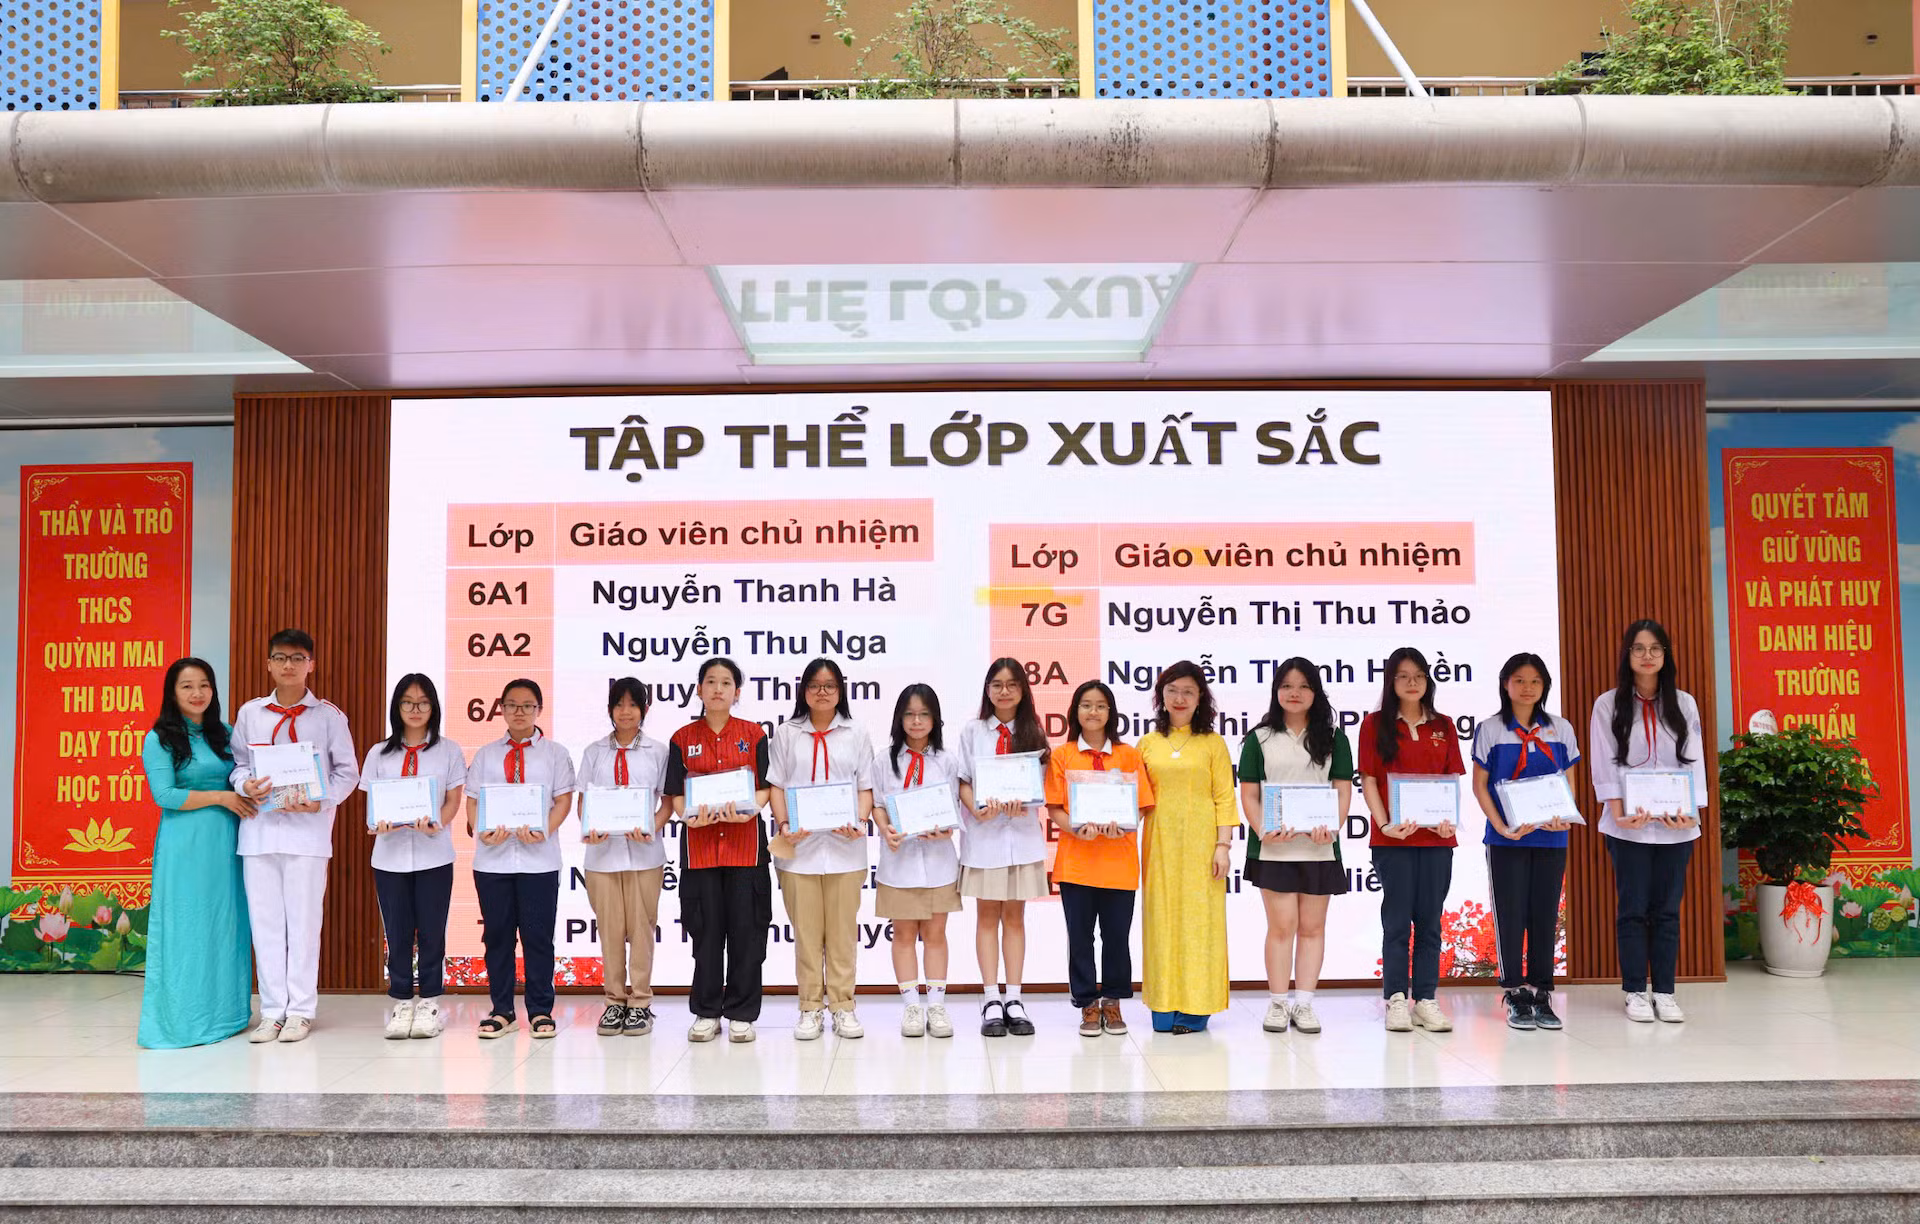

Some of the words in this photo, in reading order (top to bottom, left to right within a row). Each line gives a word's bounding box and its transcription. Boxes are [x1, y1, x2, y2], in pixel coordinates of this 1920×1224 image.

[570, 415, 704, 482] TẬP
[725, 406, 868, 468] THỂ
[891, 411, 1028, 466] LỚP
[1048, 412, 1236, 465] XUẤT
[1256, 408, 1380, 465] SẮC
[40, 500, 92, 535] THẦY
[100, 504, 126, 534] VÀ
[134, 502, 172, 533] TRÒ
[1752, 483, 1815, 521] QUYẾT
[1824, 487, 1867, 517] TÂM
[469, 523, 533, 553] Lớp
[570, 522, 647, 546] Giáo
[658, 521, 727, 545] viên
[741, 519, 802, 544] chủ
[816, 520, 918, 549] nhiệm
[1763, 531, 1799, 562] GIỮ
[1804, 531, 1860, 562] VỮNG
[64, 546, 147, 579] TRƯỜNG
[1012, 543, 1079, 573] Lớp
[1115, 543, 1192, 567] Giáo
[1204, 543, 1273, 567] viên
[1286, 542, 1346, 567] chủ
[1360, 542, 1460, 572] nhiệm
[469, 582, 527, 605] 6A1
[594, 574, 720, 610] Nguyễn
[734, 579, 838, 602] Thanh
[854, 577, 895, 601] Hà
[1746, 576, 1772, 606] VÀ
[1780, 576, 1832, 606] PHÁT
[1841, 581, 1880, 606] HUY
[78, 597, 131, 623] THCS
[1022, 602, 1067, 626] 7G
[1109, 596, 1236, 632] Nguyễn
[1250, 601, 1300, 631] Thị
[1313, 601, 1375, 624] Thu
[1388, 599, 1470, 624] Thảo
[45, 637, 115, 671] QUỲNH
[123, 641, 163, 667] MAI
[468, 633, 530, 657] 6A2
[603, 626, 731, 662] Nguyễn
[744, 631, 806, 654] Thu
[821, 630, 887, 660] Nga
[1759, 626, 1816, 651] DANH
[1824, 619, 1872, 656] HIỆU
[1025, 661, 1068, 685] 8A
[1108, 654, 1237, 691] Ngễn
[1250, 659, 1354, 683] Tnh
[1367, 651, 1472, 682] Hền
[1775, 662, 1859, 695] TRƯỜNG
[62, 686, 94, 712] THI
[101, 686, 144, 712] ĐUA
[60, 731, 100, 763] DẠY
[108, 721, 145, 756] TỐT
[58, 775, 100, 808] HỌC
[108, 765, 145, 801] TỐT
